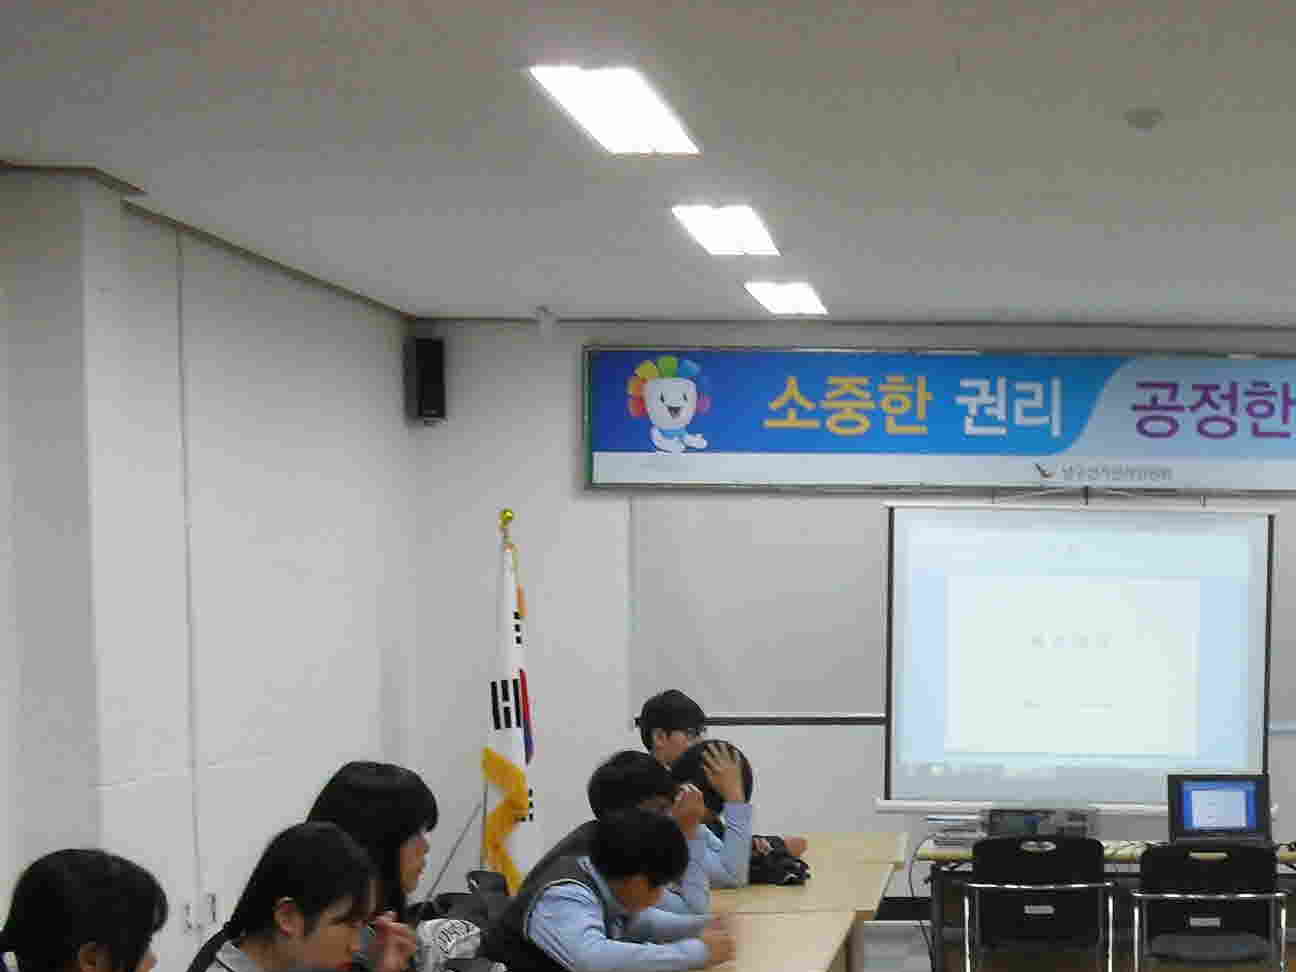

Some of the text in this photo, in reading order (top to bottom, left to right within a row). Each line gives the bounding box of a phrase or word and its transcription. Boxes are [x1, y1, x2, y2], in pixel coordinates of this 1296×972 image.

[763, 375, 932, 436] 소중한
[955, 376, 1062, 438] 권리
[1131, 379, 1296, 440] 공정한
